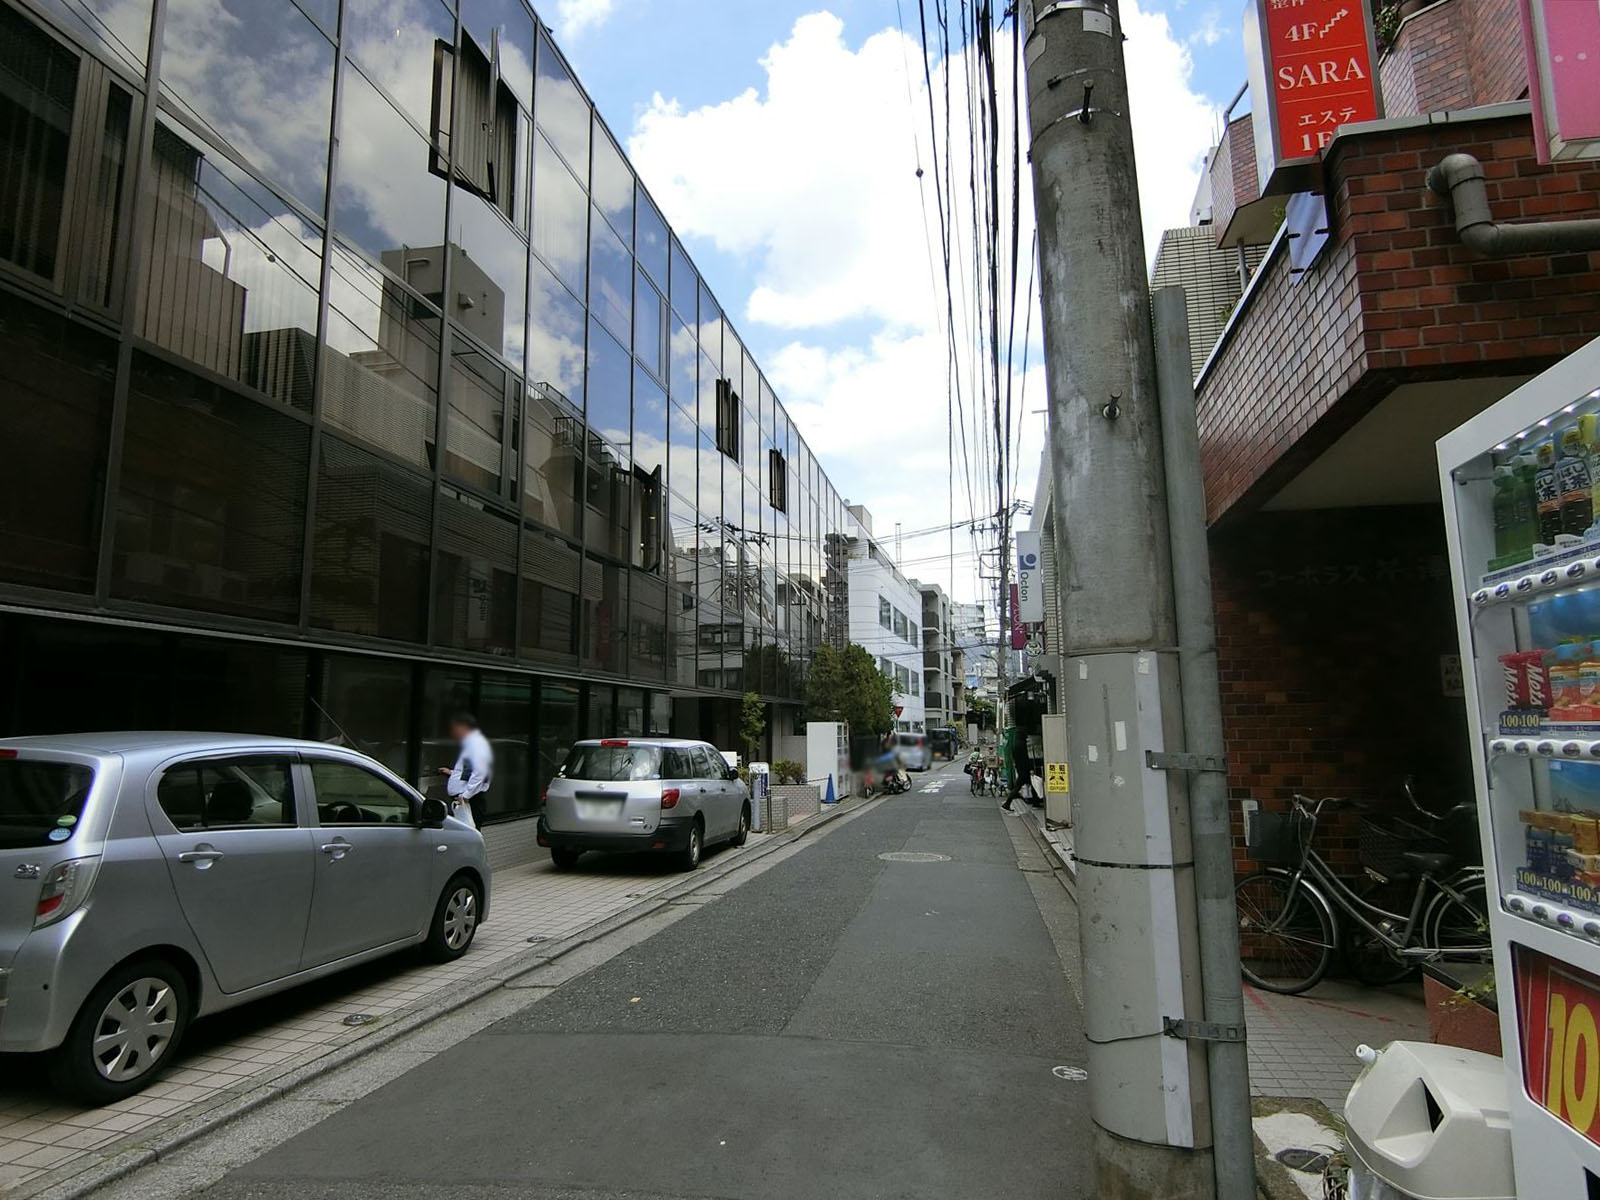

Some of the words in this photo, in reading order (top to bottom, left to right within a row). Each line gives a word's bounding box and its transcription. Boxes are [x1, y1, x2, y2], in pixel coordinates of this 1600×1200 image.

[1284, 22, 1320, 42] 4F
[1278, 56, 1367, 91] SARA
[1298, 106, 1357, 127] エステ
[1020, 571, 1029, 602] Octon
[1526, 661, 1546, 706] Mets
[1502, 714, 1519, 727] 100
[1521, 714, 1540, 727] 100
[1518, 870, 1536, 886] 100
[1542, 877, 1561, 893] 100
[1570, 885, 1591, 902] 100
